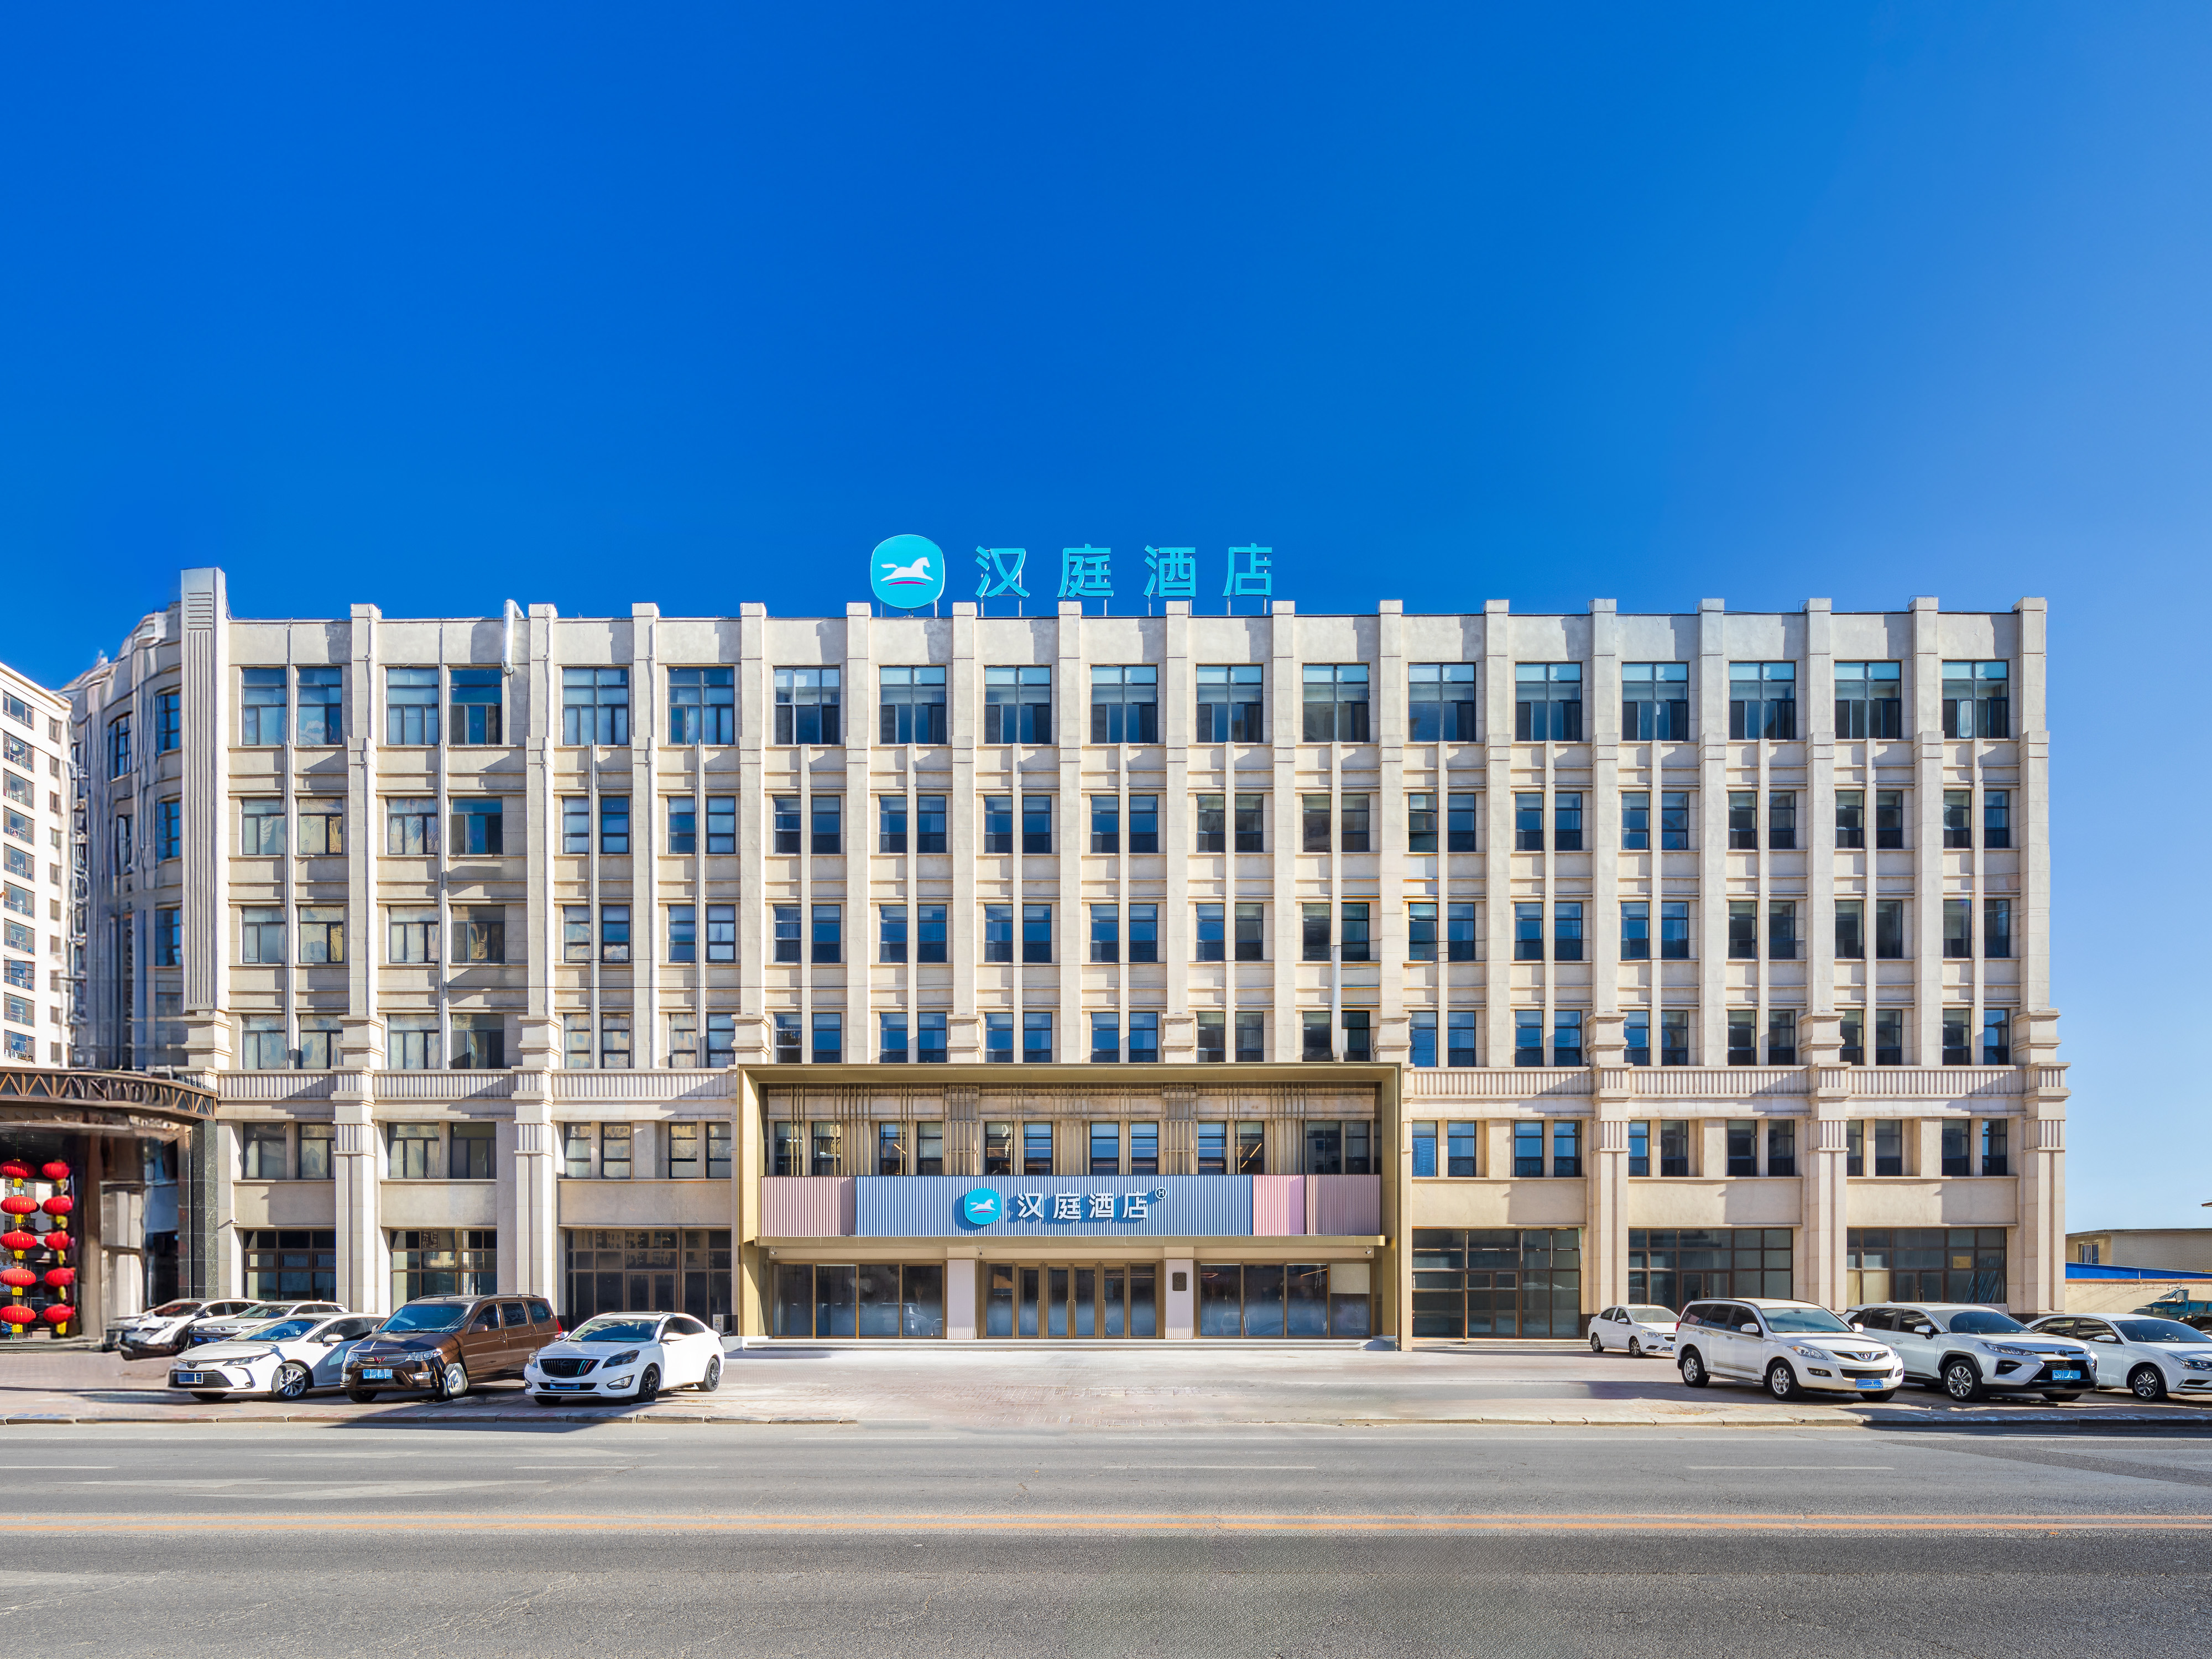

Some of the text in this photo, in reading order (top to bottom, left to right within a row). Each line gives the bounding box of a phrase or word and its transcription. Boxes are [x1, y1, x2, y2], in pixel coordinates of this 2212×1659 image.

[975, 542, 1272, 598] 汉庭酒店
[1017, 1191, 1147, 1219] 汉庭酒店
